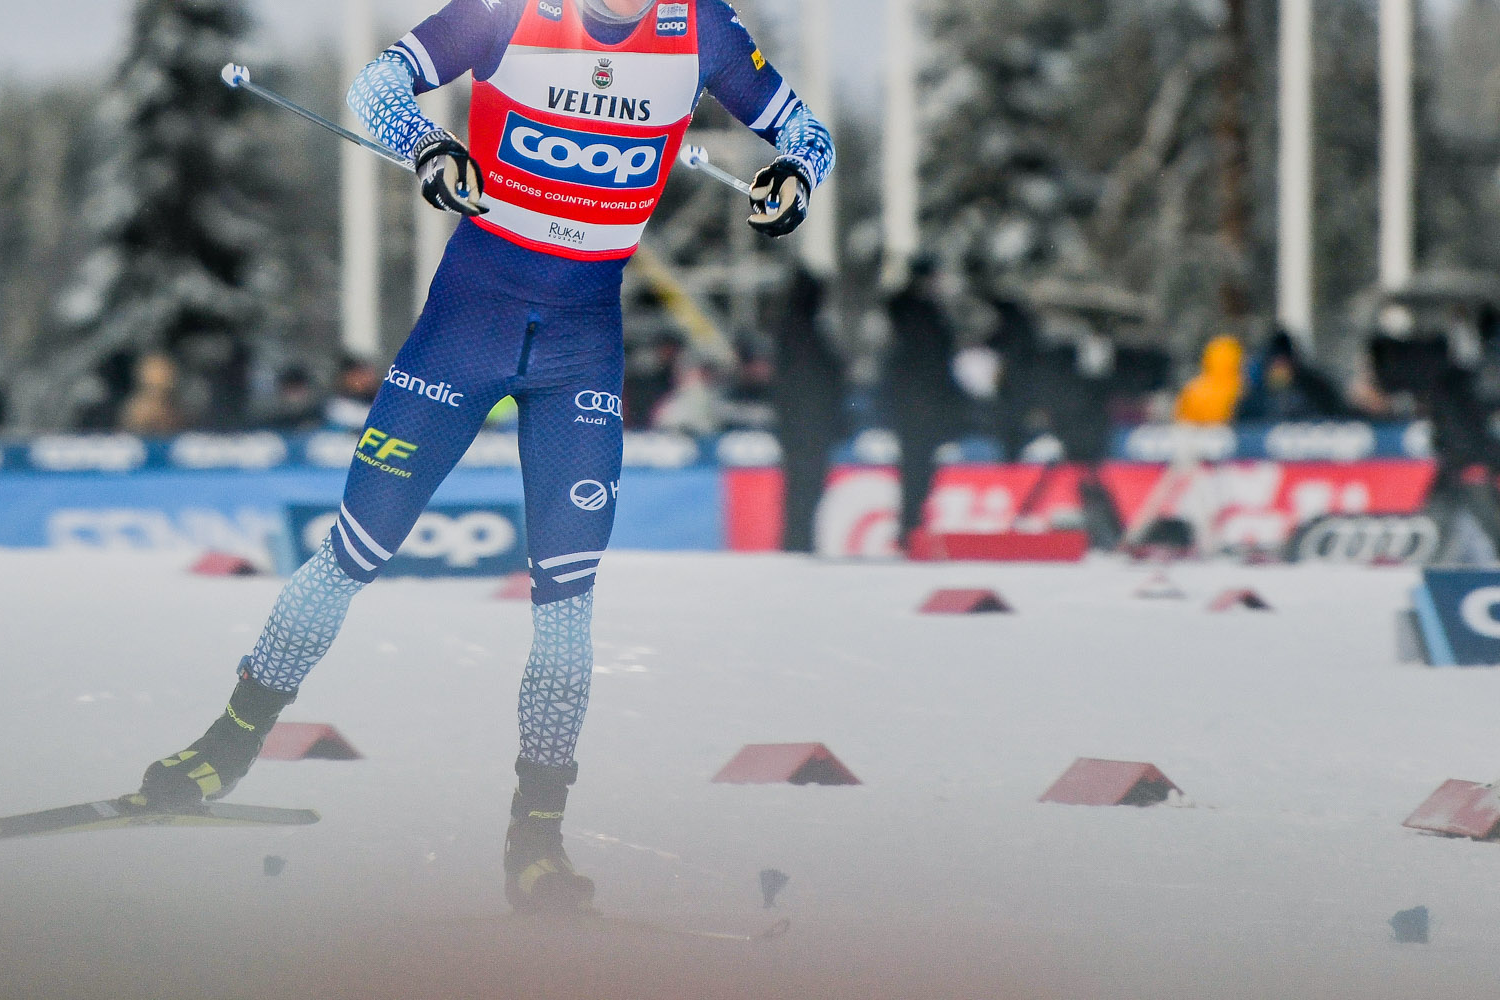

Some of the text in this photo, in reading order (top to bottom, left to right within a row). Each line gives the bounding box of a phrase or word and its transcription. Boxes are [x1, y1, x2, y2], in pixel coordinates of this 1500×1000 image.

[540, 1, 562, 17] coop
[657, 21, 687, 32] coop
[548, 86, 651, 121] VELTINS
[510, 126, 657, 184] coop
[488, 171, 655, 210] FIS CROSS COUNTRY WORLD CUP
[384, 364, 464, 407] Scandic
[573, 415, 607, 426] Audi
[357, 427, 419, 460] FF
